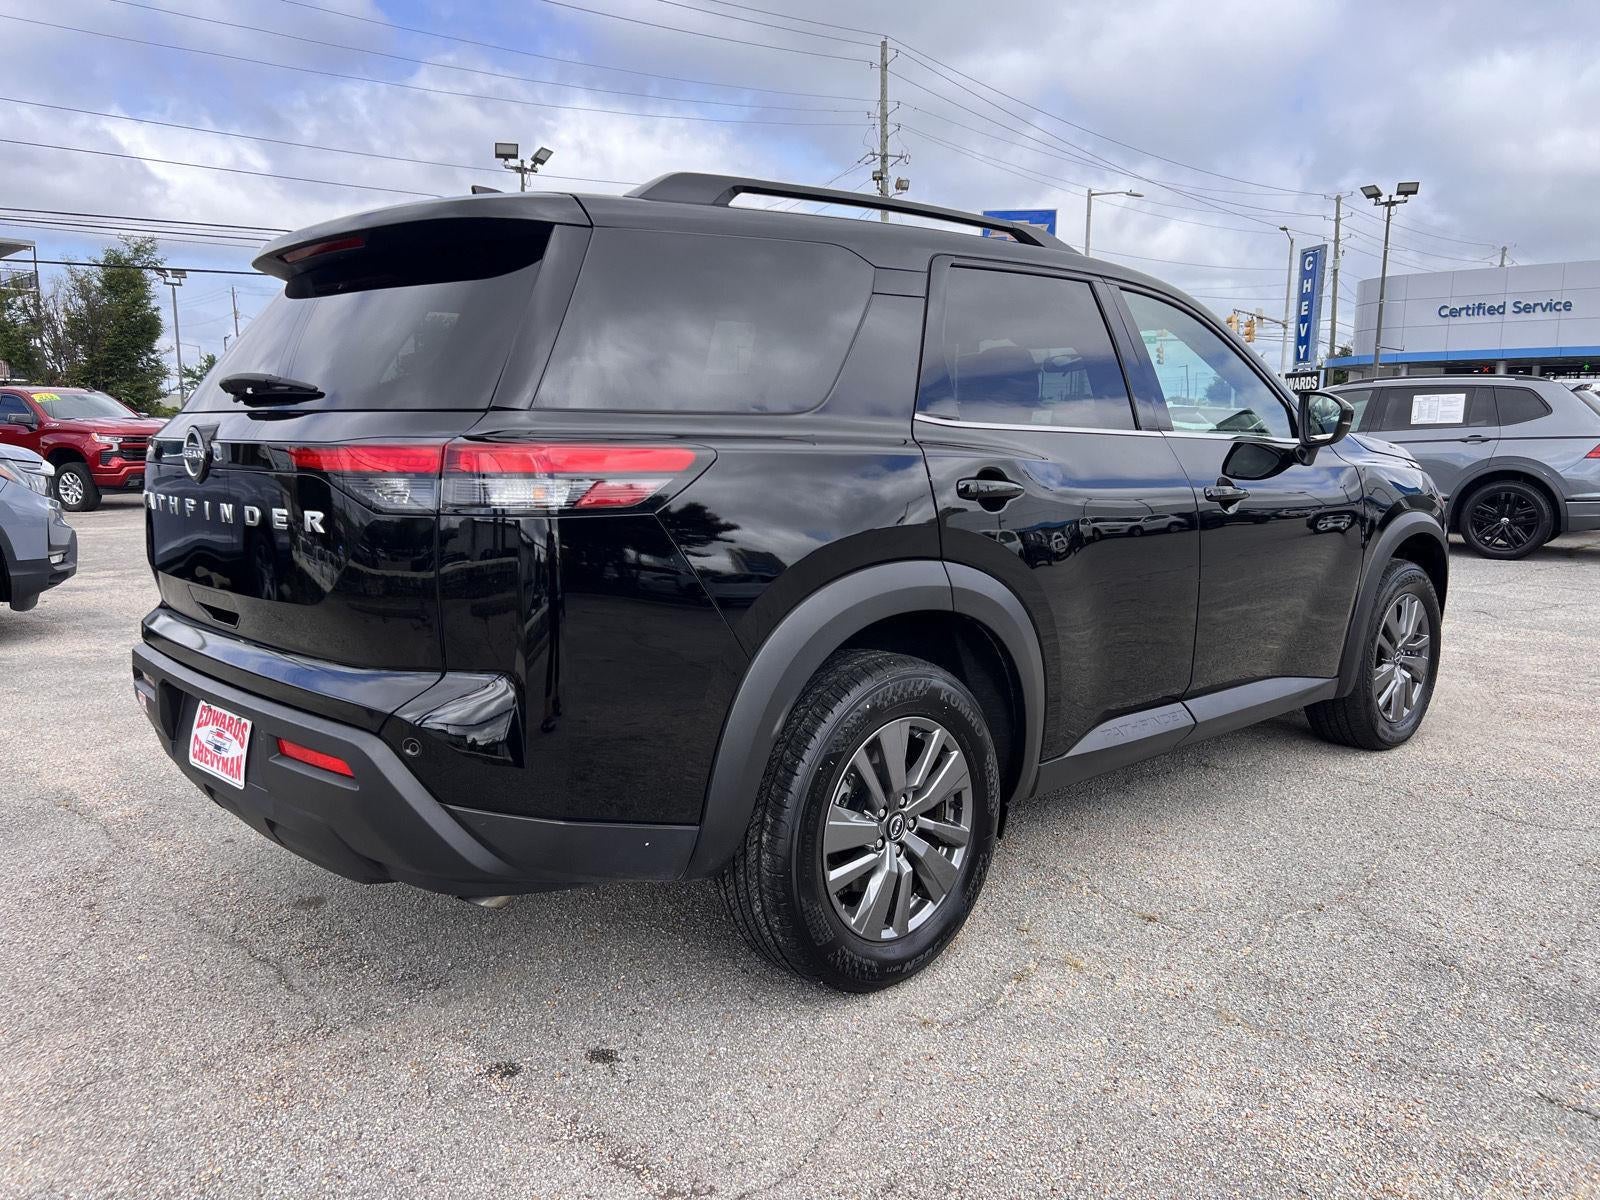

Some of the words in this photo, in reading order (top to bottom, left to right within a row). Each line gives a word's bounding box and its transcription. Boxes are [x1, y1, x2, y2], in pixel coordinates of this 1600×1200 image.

[1298, 256, 1314, 360] CHEVY
[1438, 301, 1506, 318] Certified
[1512, 299, 1573, 315] Service
[1286, 375, 1318, 390] WARDS
[184, 449, 205, 459] SSAN
[196, 704, 248, 750] EDWARDS
[939, 688, 984, 737] KUMHO
[192, 733, 243, 781] CHEVYMAN
